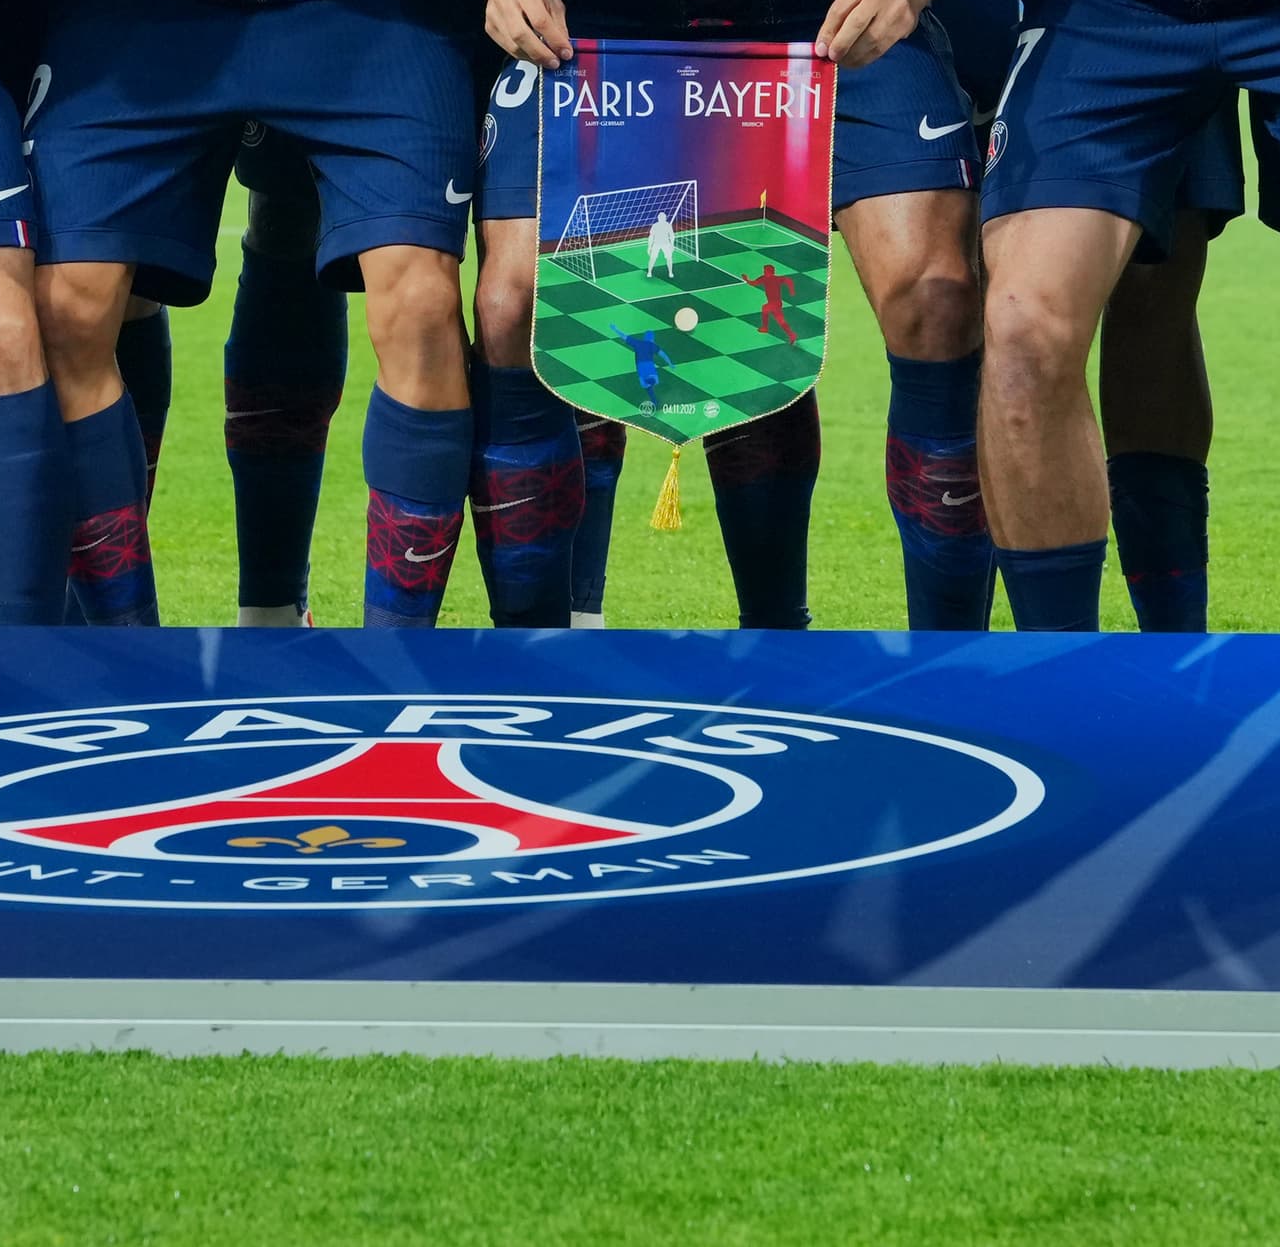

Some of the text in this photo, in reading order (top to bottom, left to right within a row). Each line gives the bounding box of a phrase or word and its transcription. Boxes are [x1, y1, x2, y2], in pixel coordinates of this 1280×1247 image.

[554, 80, 821, 119] PARIS BAYERN
[242, 849, 751, 891] GERMAIN
